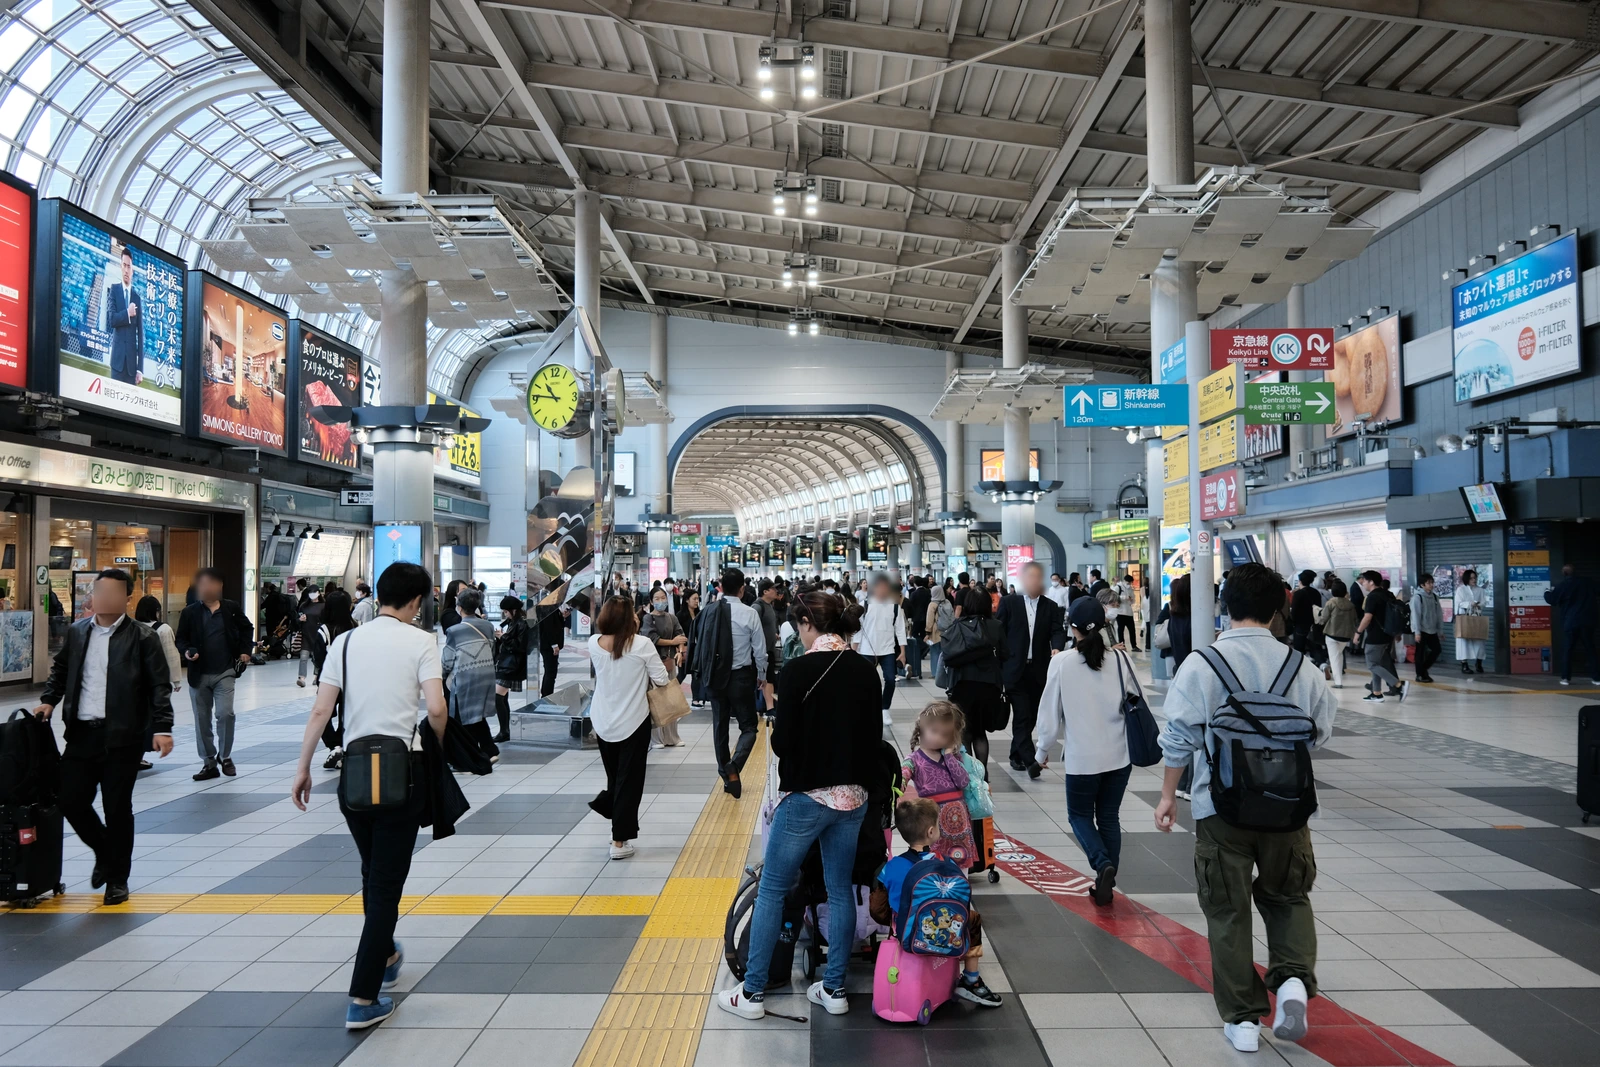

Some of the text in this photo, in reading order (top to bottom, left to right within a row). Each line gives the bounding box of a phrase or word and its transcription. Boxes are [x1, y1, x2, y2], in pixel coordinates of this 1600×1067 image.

[146, 262, 157, 326] 技術で。
[1458, 267, 1529, 307] 「ホワイト運用」で
[1459, 267, 1572, 322] 未知のマルウェア感染をブロックする
[156, 268, 167, 389] オンリーワンの
[167, 272, 177, 390] 医療の未来を、
[1538, 319, 1567, 338] i-FILTER
[1233, 335, 1269, 348] 京急線
[1276, 343, 1296, 355] KK
[1539, 334, 1573, 354] m-FILTER
[302, 338, 346, 369] 食のプロは選ぶ
[550, 367, 560, 378] 12
[571, 391, 578, 402] 3
[1124, 388, 1160, 400] 新幹線
[1259, 385, 1301, 396] 中央改札
[532, 394, 539, 405] 9
[1124, 401, 1166, 409] Shinkansen
[1261, 396, 1302, 404] Central Gate
[202, 413, 283, 447] SIMMONS GALLERY TOKYO
[551, 418, 558, 429] 6
[6, 455, 31, 469] Office
[105, 466, 164, 491] みどりの窓口
[168, 476, 224, 500] Ticket Office
